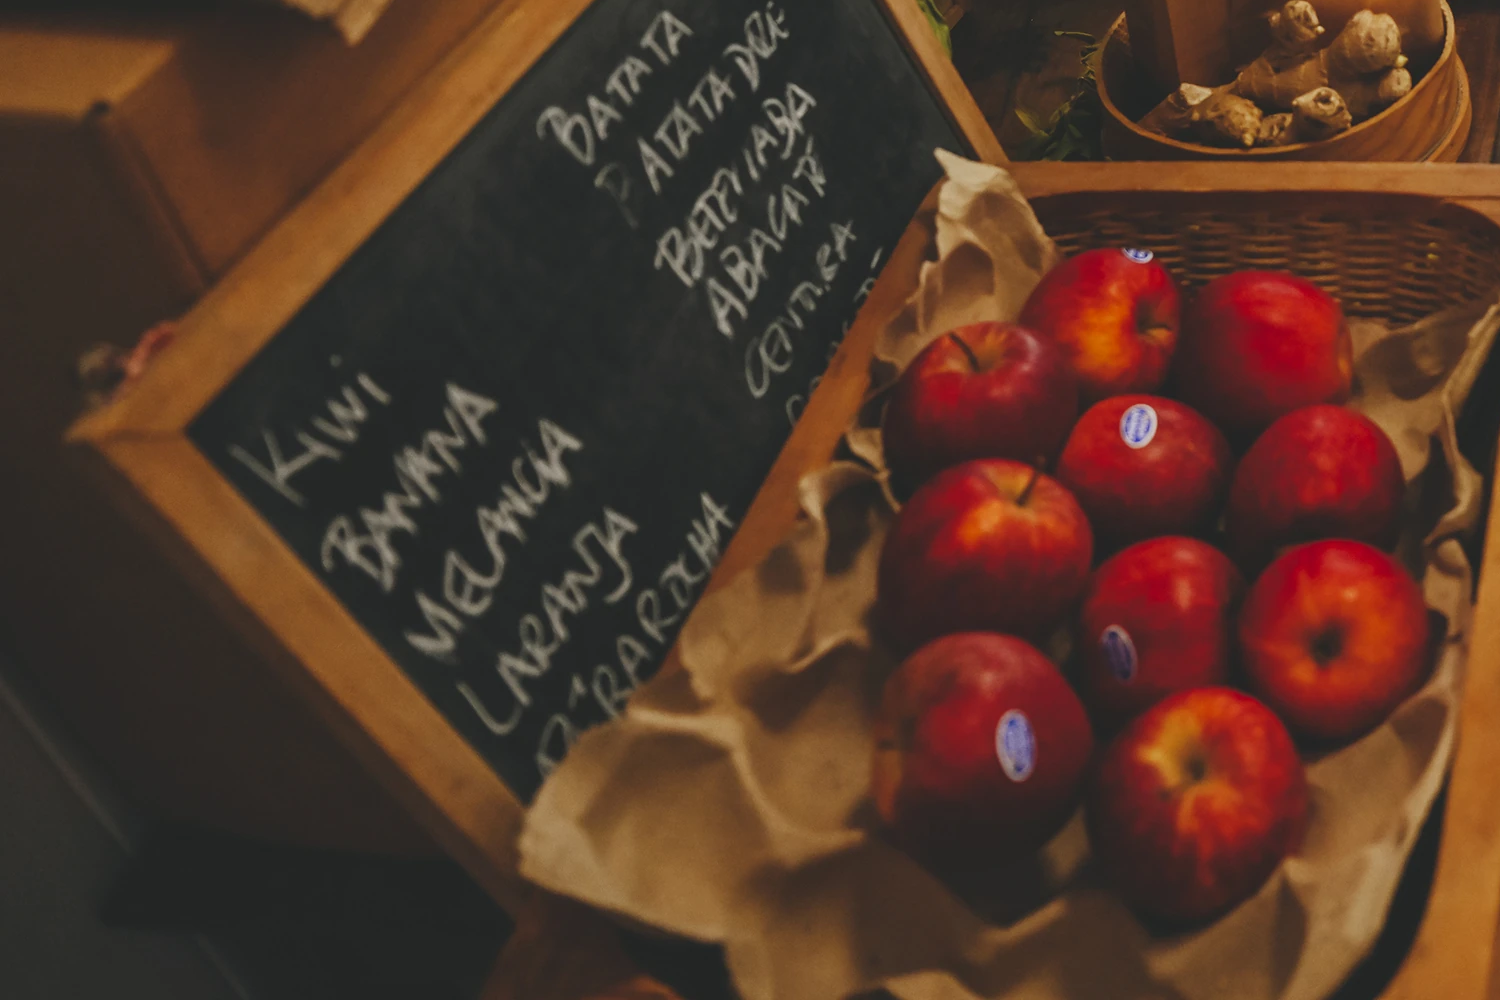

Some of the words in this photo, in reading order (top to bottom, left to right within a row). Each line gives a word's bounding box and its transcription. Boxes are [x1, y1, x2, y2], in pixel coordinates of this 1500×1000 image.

[535, 9, 695, 167] BATATA
[320, 380, 500, 592] BANANA
[403, 417, 585, 660] MELANCIA
[456, 505, 640, 736] LARANJA
